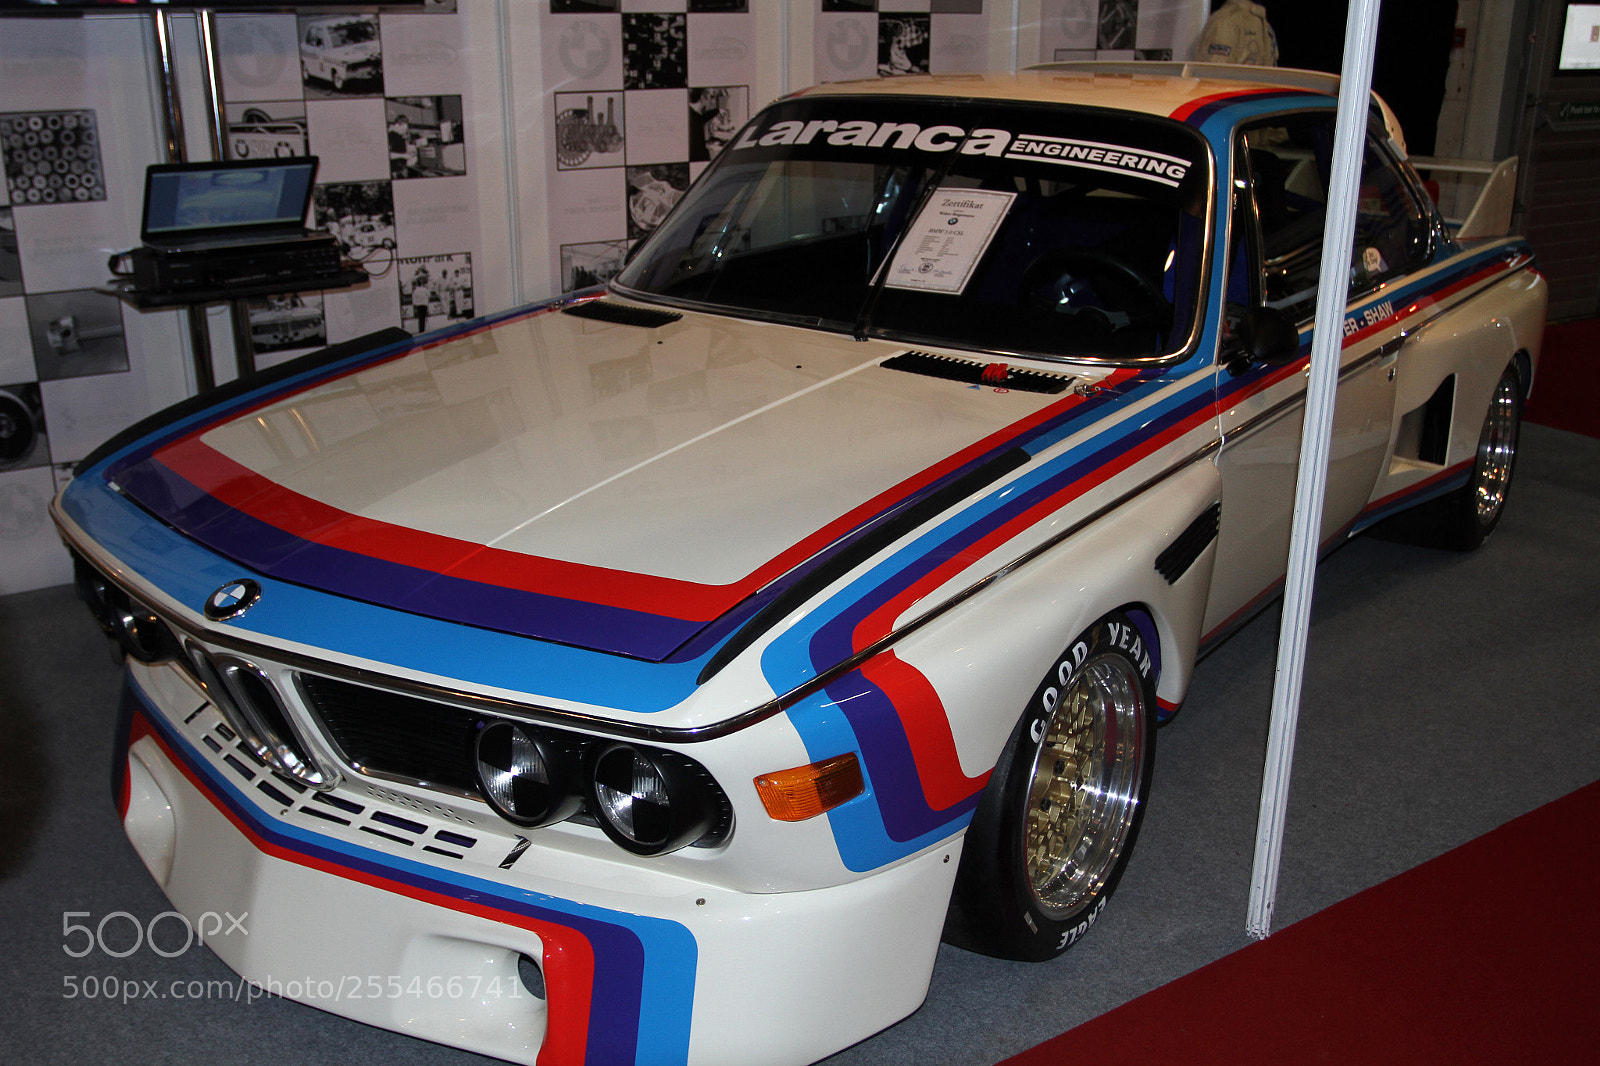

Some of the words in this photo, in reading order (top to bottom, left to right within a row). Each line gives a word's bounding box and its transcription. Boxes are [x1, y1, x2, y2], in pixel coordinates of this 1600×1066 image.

[732, 119, 1012, 158] Laranca
[1009, 139, 1187, 180] ENGINEERING
[941, 198, 984, 210] Zertifikat
[1343, 317, 1360, 337] ER
[1363, 300, 1394, 327] SHAW
[1030, 641, 1088, 744] GOOD
[1107, 622, 1151, 679] YEAR
[1055, 895, 1107, 950] EAGLE
